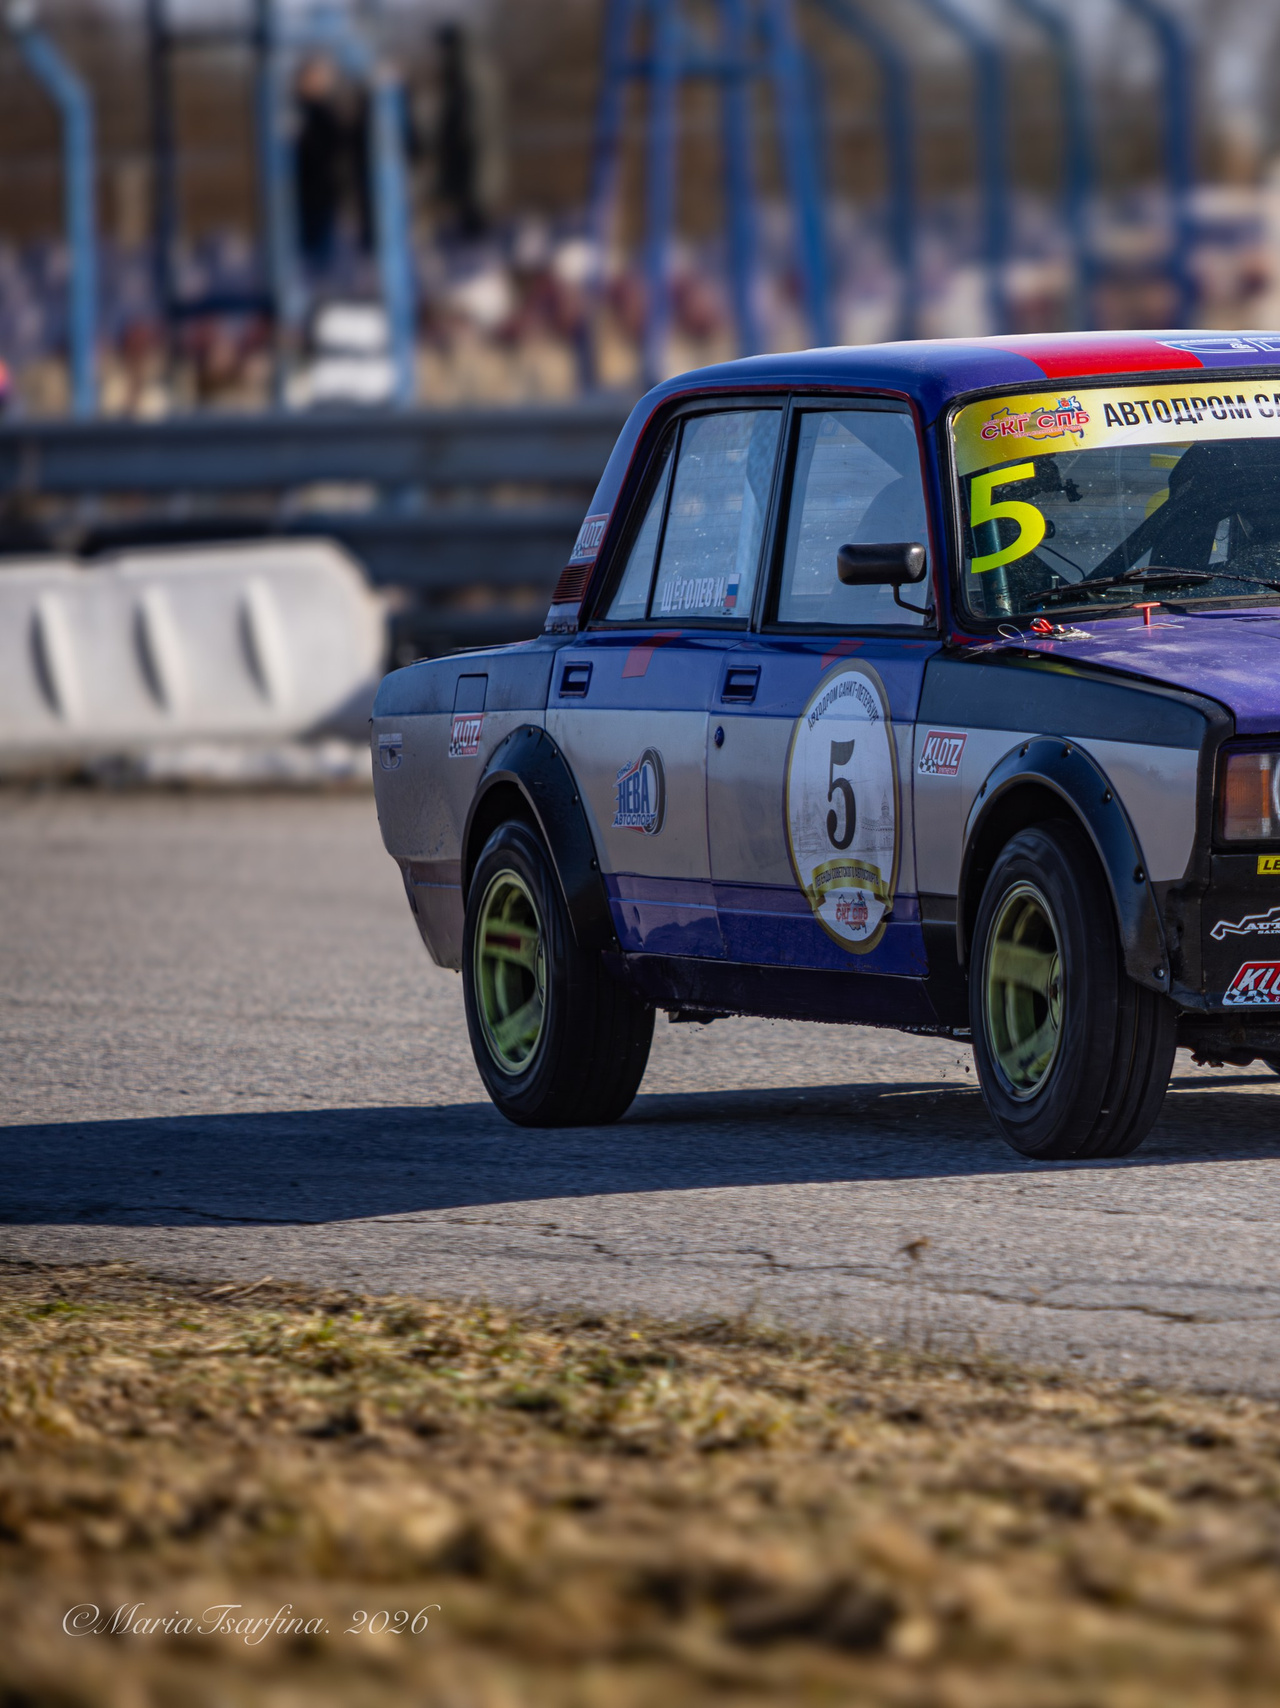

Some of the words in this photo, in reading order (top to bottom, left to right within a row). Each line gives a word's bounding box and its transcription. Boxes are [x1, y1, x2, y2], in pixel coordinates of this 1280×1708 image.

[981, 417, 1029, 440] СКГ
[1036, 411, 1090, 429] СПБ
[1103, 394, 1252, 427] АВТОДРОМ
[970, 462, 1046, 574] 5
[807, 684, 839, 732] АВТОДРОМ
[839, 680, 879, 726] САНКТ-ПЕТЕРБУРГ
[453, 720, 481, 747] KLOTZ
[924, 736, 964, 766] KLOTZ
[617, 765, 650, 814] НЕВА
[826, 739, 856, 850] 5
[614, 813, 656, 826] АВТОСПОРТ
